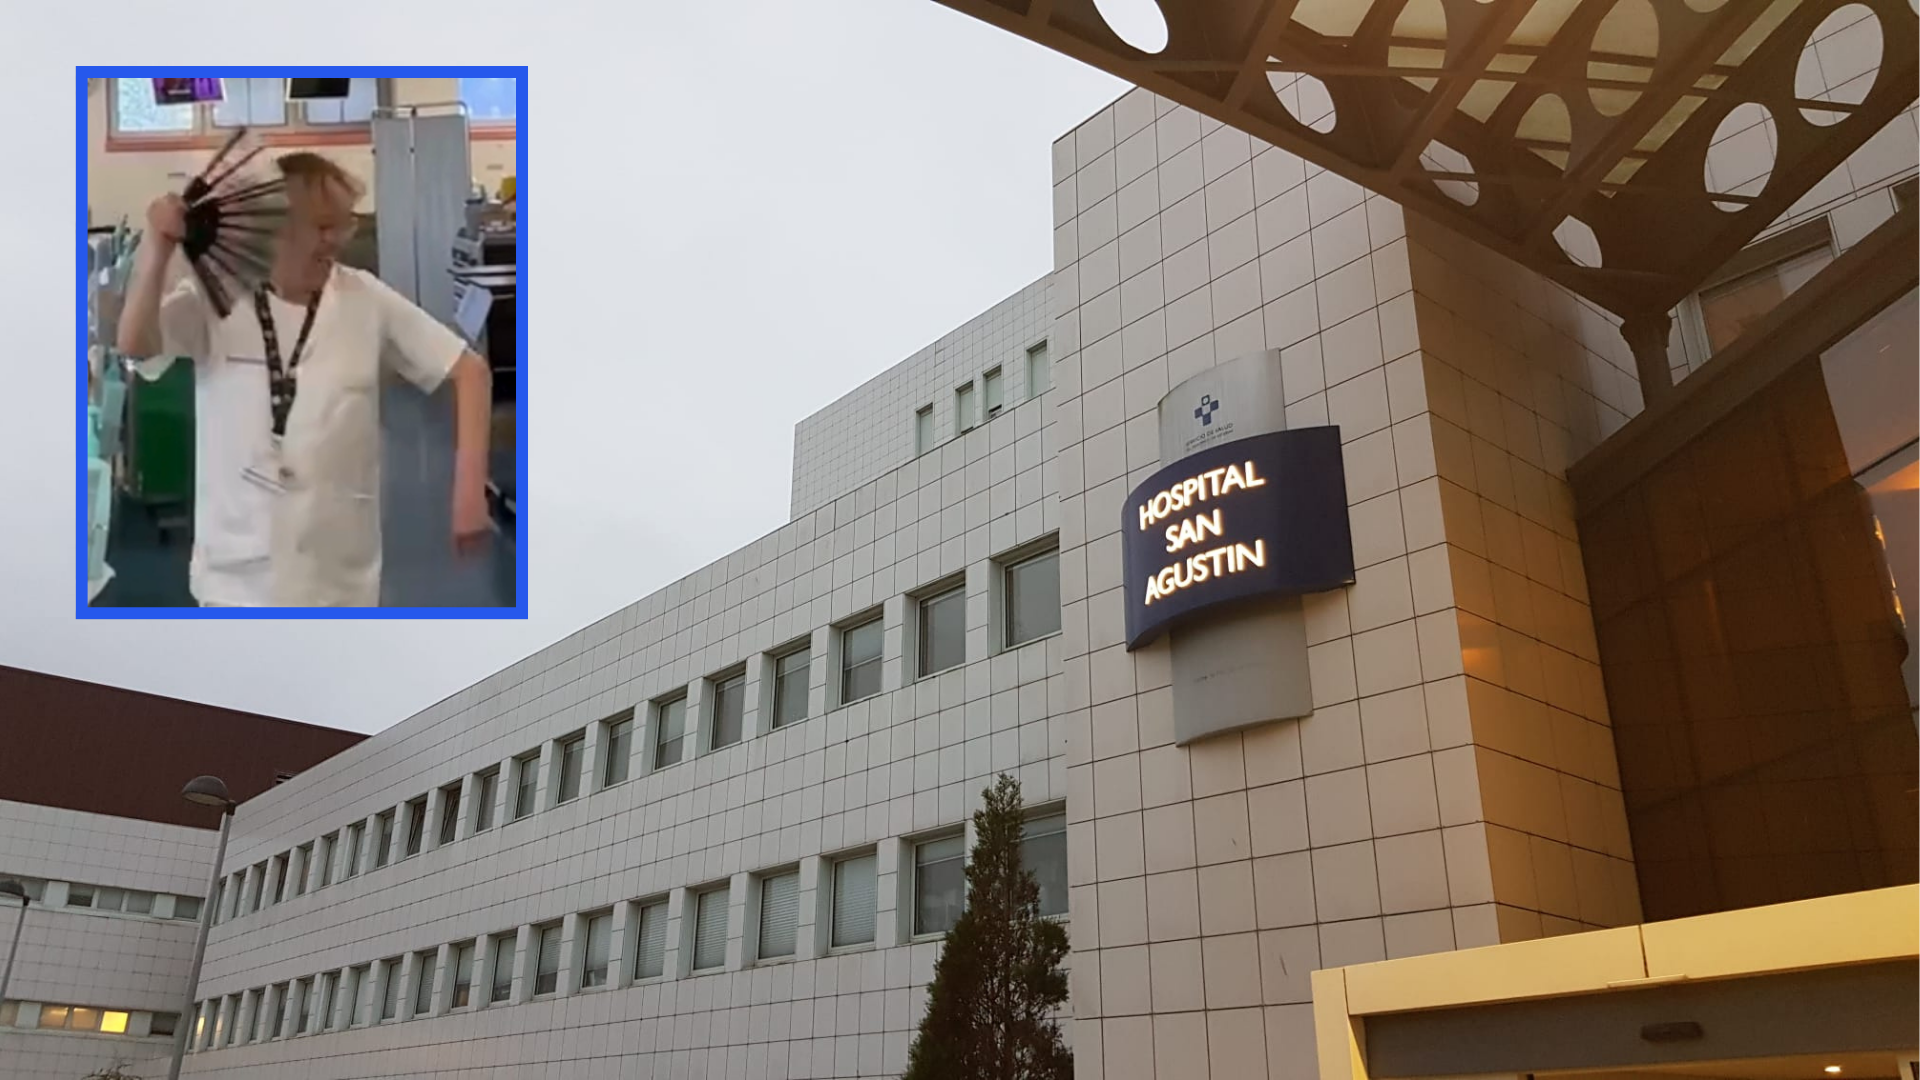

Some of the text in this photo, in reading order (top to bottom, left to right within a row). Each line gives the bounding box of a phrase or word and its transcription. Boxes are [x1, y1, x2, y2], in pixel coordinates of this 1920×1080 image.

[1139, 460, 1266, 531] HOSPITAL
[1165, 508, 1222, 553] SAN
[1144, 539, 1265, 605] AGUSTIN
